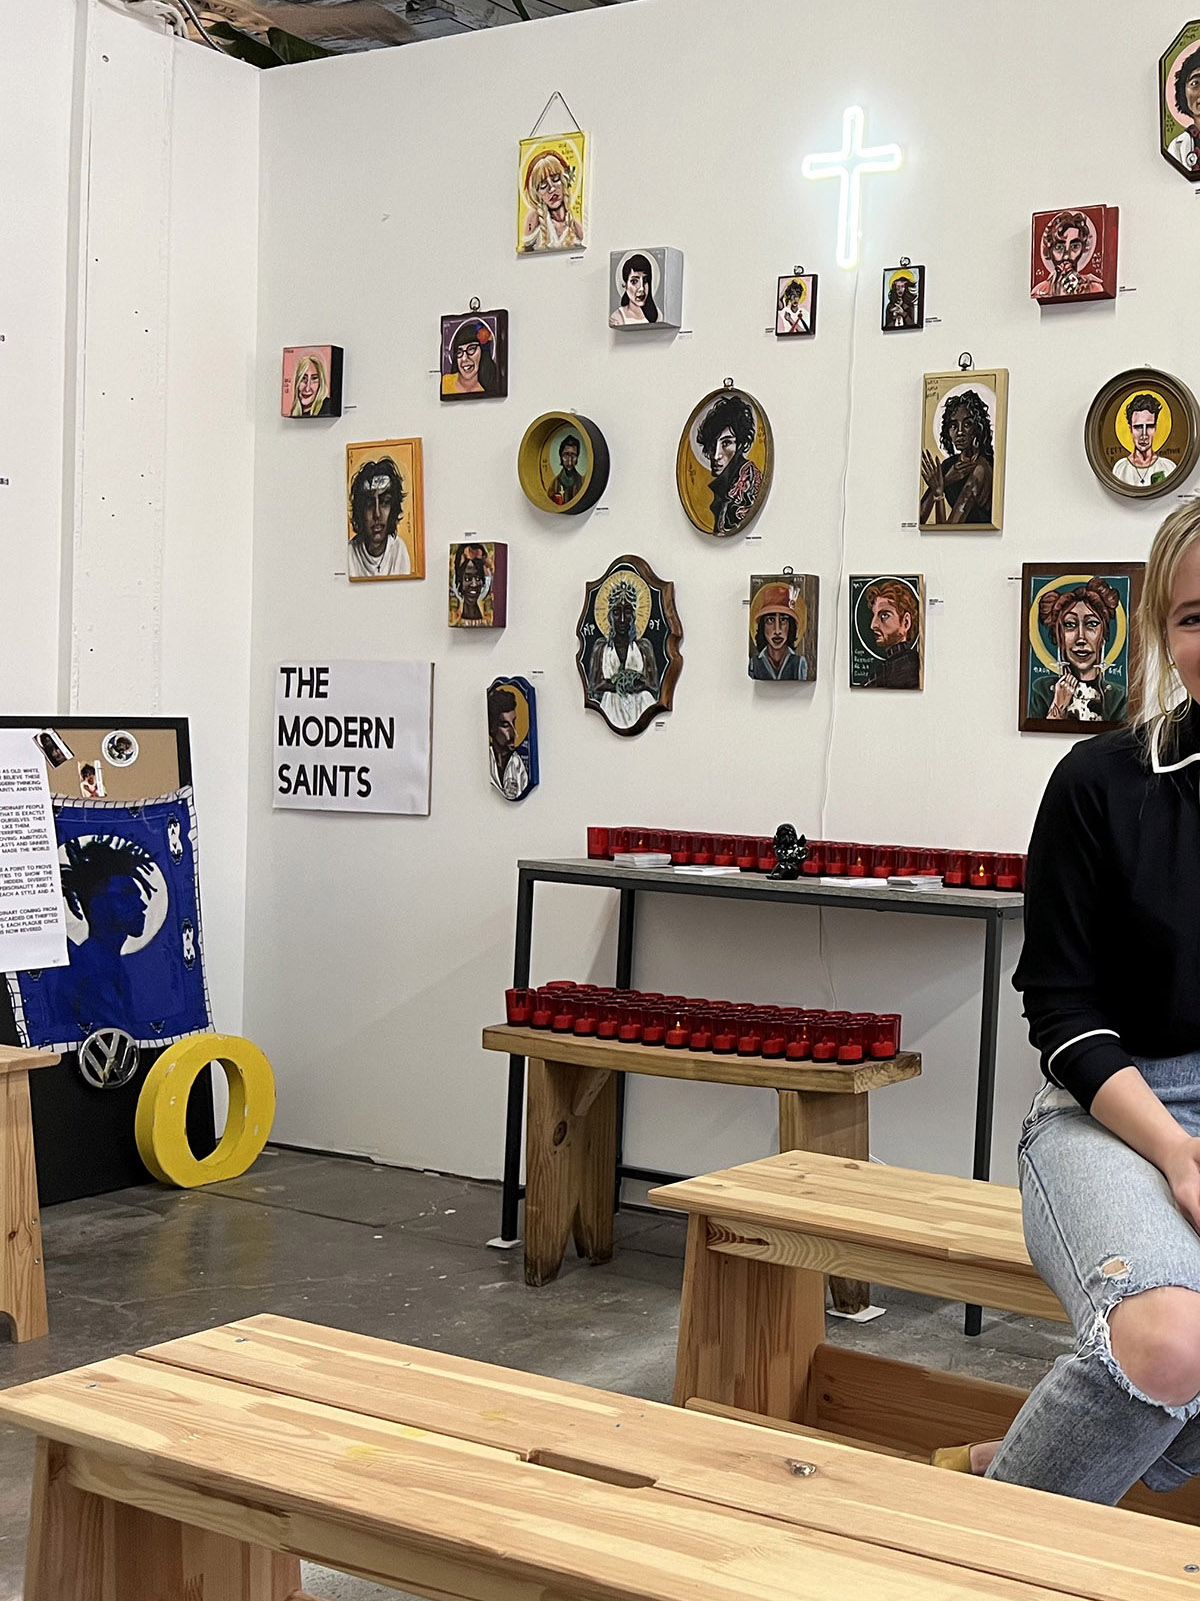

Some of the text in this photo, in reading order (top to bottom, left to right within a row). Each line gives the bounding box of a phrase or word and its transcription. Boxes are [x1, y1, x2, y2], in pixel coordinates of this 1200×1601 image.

[280, 667, 329, 698] THE
[278, 715, 394, 749] MODERN
[278, 763, 372, 798] SAINTS
